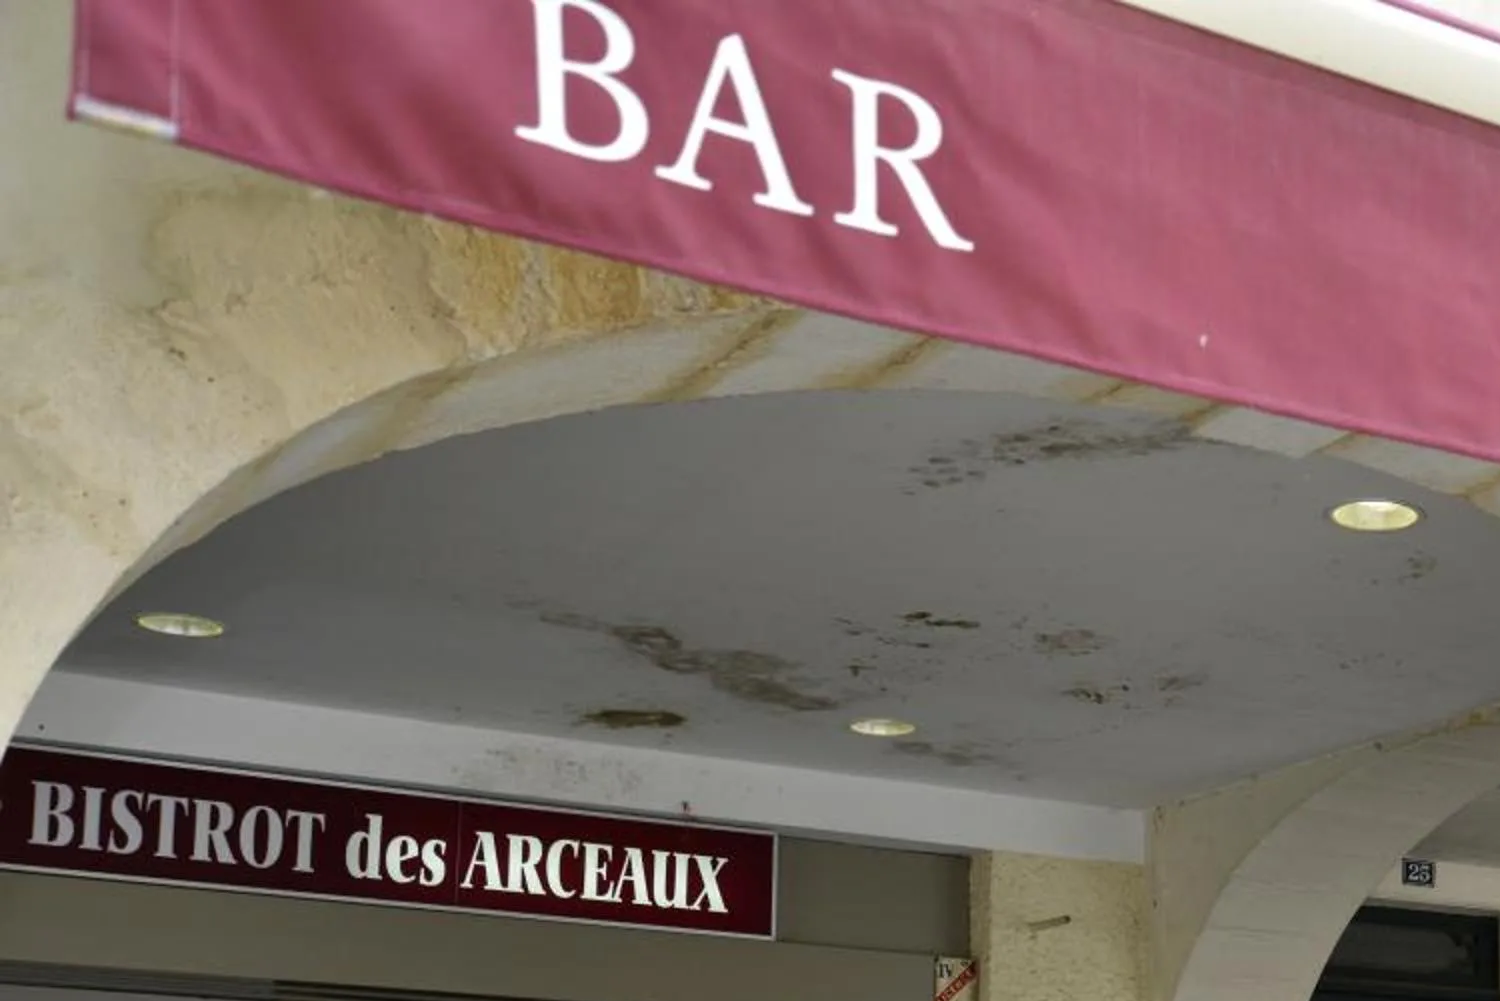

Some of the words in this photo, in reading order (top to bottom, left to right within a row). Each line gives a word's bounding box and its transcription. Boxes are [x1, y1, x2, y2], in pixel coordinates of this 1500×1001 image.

[515, 0, 975, 251] BAR
[28, 779, 326, 874] BISTROT
[345, 813, 447, 887] des
[460, 831, 729, 914] ARCEAUX
